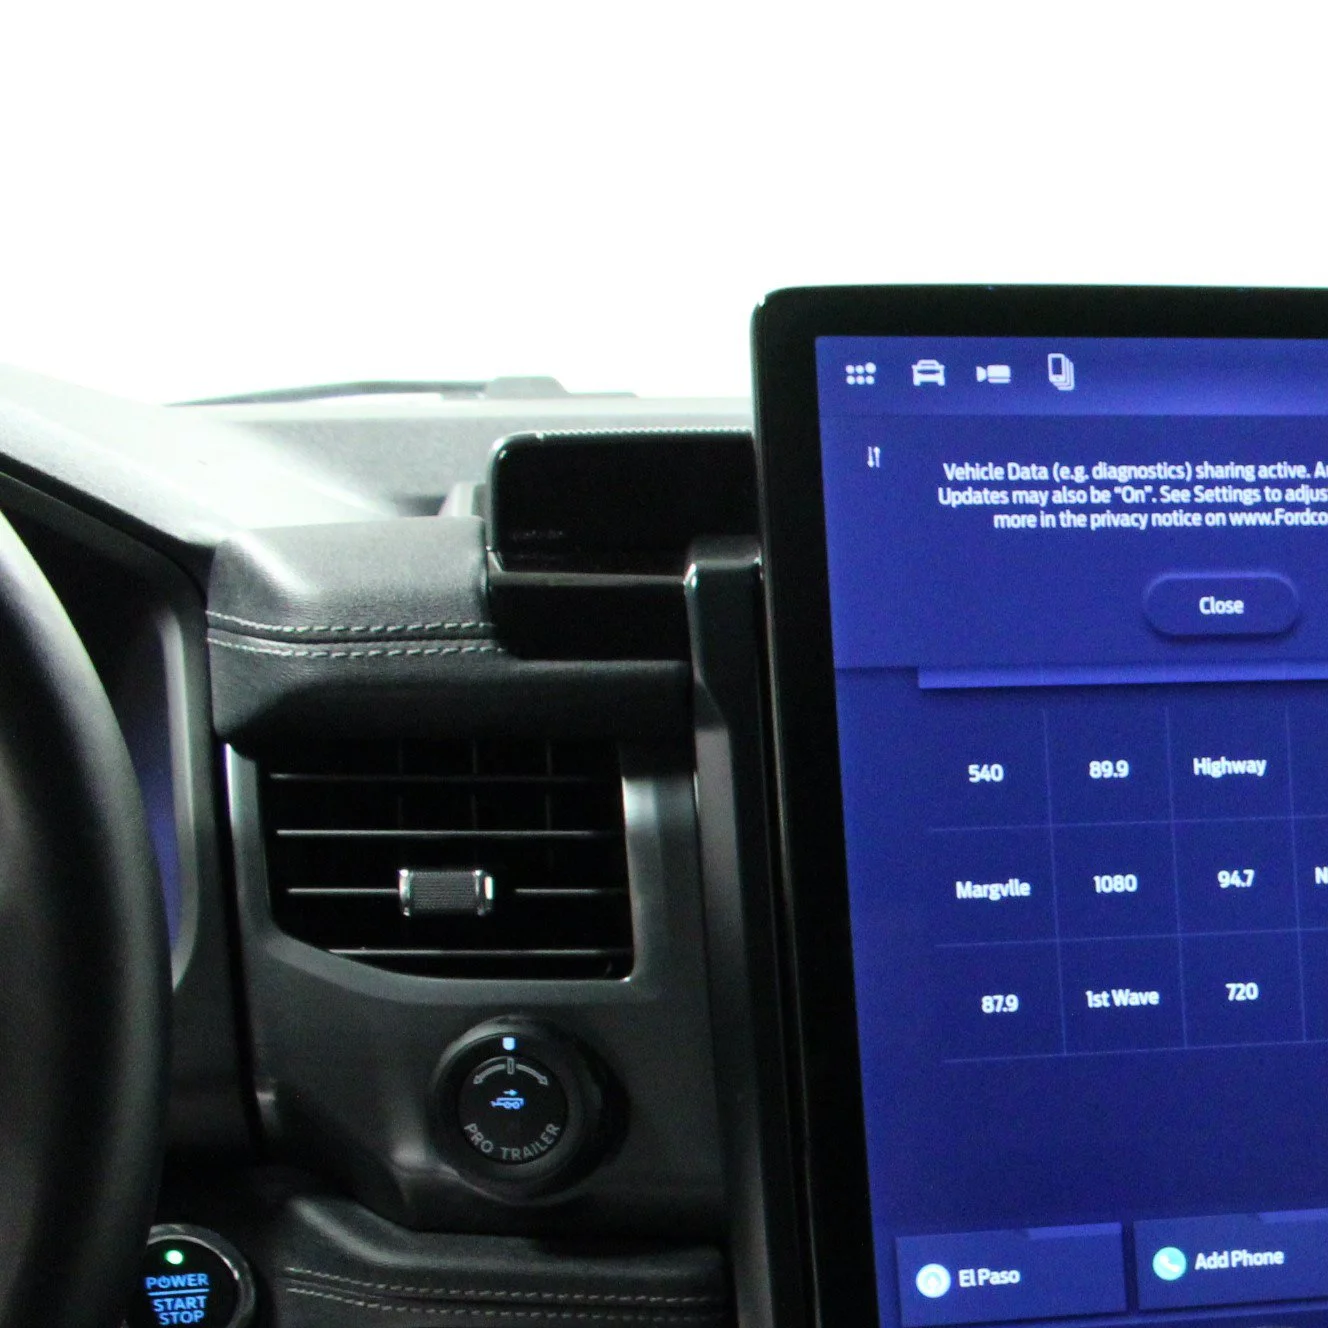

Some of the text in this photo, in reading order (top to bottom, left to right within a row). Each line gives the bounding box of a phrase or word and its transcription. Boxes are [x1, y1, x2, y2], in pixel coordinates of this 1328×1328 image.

[942, 461, 1005, 482] Vehicle
[1006, 461, 1050, 481] Data
[1052, 461, 1090, 484] (e.g.
[1091, 460, 1193, 484] diagnostics)
[1194, 460, 1257, 483] sharing
[1257, 460, 1312, 480] active.
[937, 486, 1010, 509] Updates
[1011, 489, 1050, 508] may
[1051, 485, 1088, 505] also
[1089, 485, 1112, 504] be
[1159, 484, 1192, 504] See
[1193, 484, 1262, 507] Settings
[1263, 485, 1283, 503] to
[993, 513, 1038, 529] more
[1039, 510, 1057, 529] in
[1058, 508, 1088, 529] the
[1089, 509, 1149, 531] privacy
[1150, 508, 1203, 528] notice
[1204, 511, 1227, 527] on
[1198, 595, 1245, 615] Close
[968, 763, 1005, 783] 540
[1089, 759, 1130, 779] 89.9
[1192, 756, 1267, 779] Highway
[1093, 873, 1138, 894] 1080
[1217, 868, 1255, 889] 94.7
[1085, 988, 1160, 1009] 1st Wave
[1225, 981, 1259, 1002] 720
[981, 993, 1020, 1014] 87.9
[463, 1122, 561, 1161] PRO TRAILER
[1194, 1248, 1285, 1271] Add Phone
[145, 1273, 209, 1290] POWER
[958, 1267, 1021, 1288] El Paso
[153, 1296, 205, 1312] START
[158, 1309, 205, 1326] STOP
